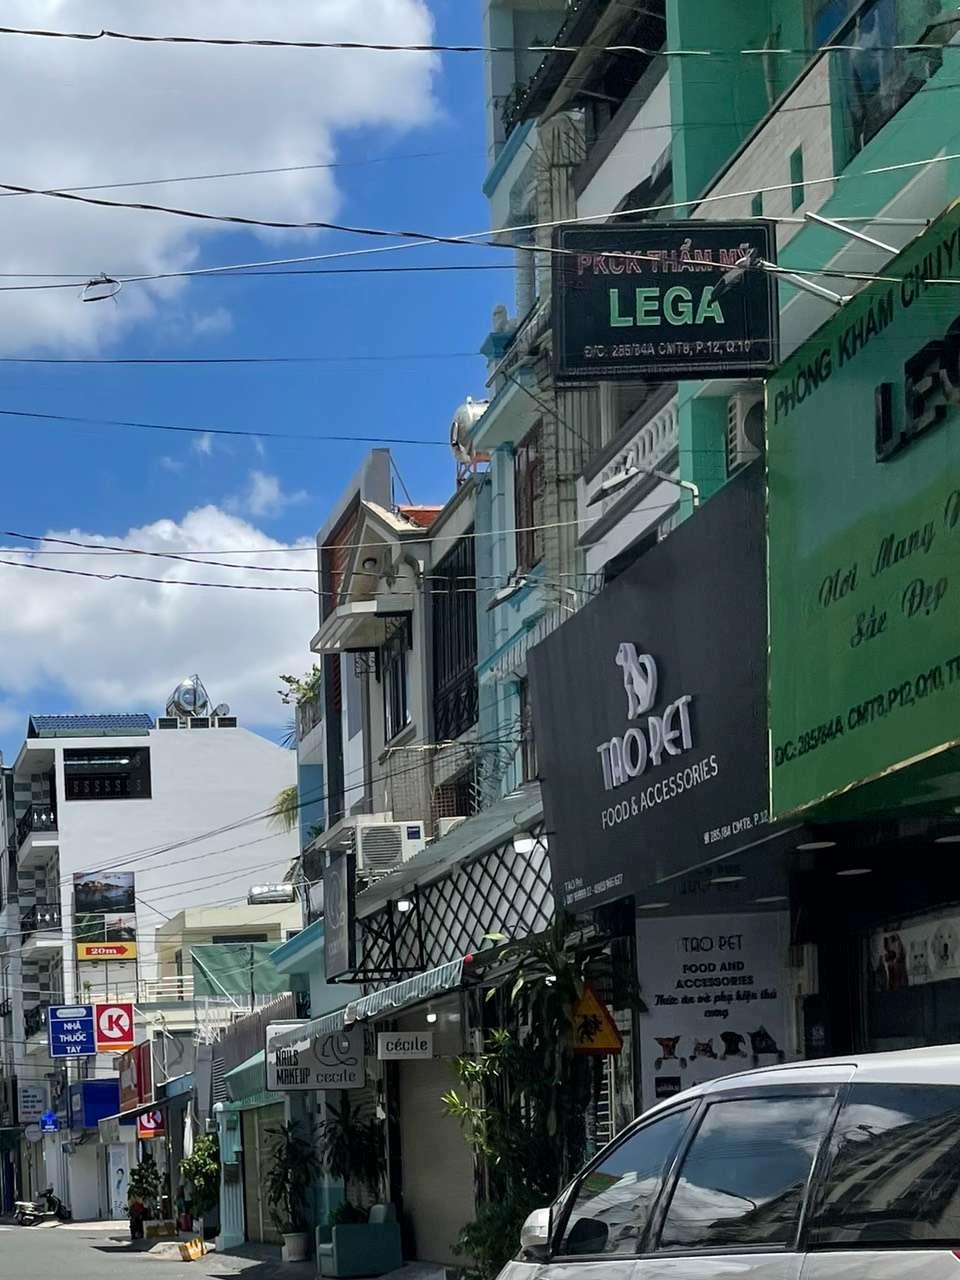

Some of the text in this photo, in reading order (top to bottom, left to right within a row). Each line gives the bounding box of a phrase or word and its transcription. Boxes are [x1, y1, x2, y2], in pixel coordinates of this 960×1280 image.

[576, 250, 642, 275] PKCK
[901, 224, 960, 308] CHUY
[610, 286, 725, 327] LEGA
[596, 695, 693, 790] TAO PET
[601, 755, 720, 830] FOOD & ACCESSORIES
[90, 947, 118, 955] 20m
[681, 934, 744, 953] TAO PET
[682, 961, 745, 974] FOOD AND
[674, 975, 754, 989] ACCESSORIES
[66, 1046, 82, 1054] TAY
[385, 1036, 429, 1052] cécile
[275, 1050, 299, 1067] NAILS
[276, 1067, 311, 1085] MAKEUP
